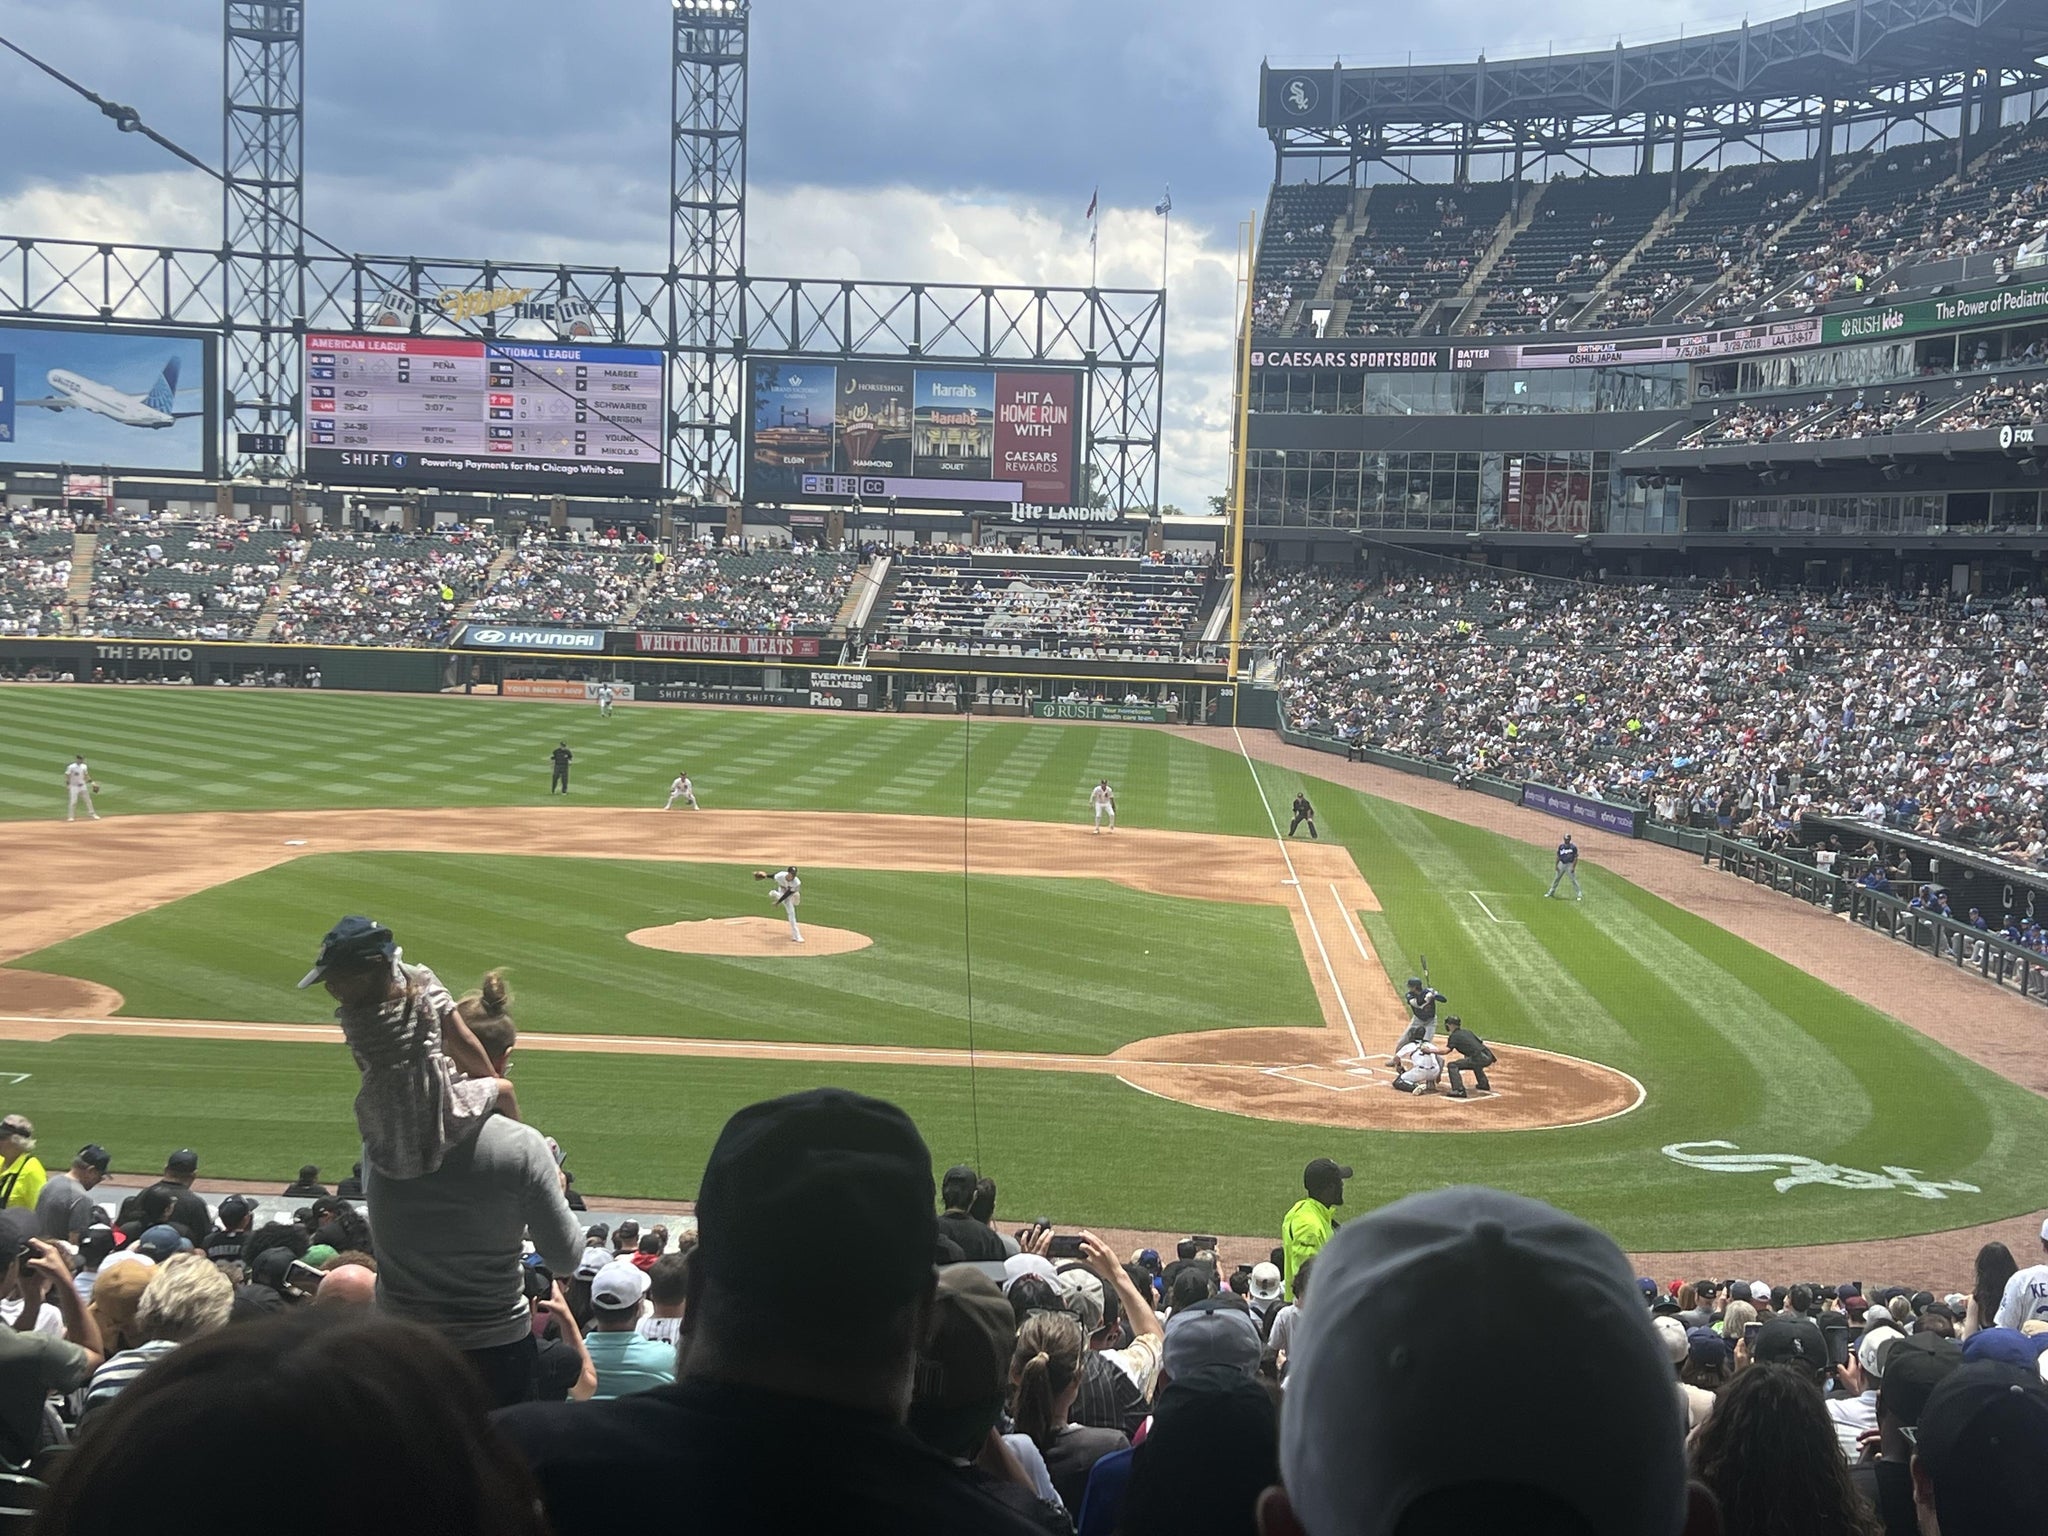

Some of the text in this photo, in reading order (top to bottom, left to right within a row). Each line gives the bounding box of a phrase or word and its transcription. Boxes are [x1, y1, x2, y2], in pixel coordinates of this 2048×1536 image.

[439, 287, 532, 323] Miller
[513, 301, 556, 320] TIME
[1936, 302, 1955, 320] The
[1957, 298, 1988, 317] Power
[1990, 295, 2002, 312] of
[559, 301, 588, 323] Lite
[1850, 307, 1904, 336] RUSH kids
[311, 340, 407, 351] AMERICAN LEAGUE
[490, 347, 581, 359] NATIONAL LEAGUE
[1267, 351, 1437, 367] CAESARS SPORTSBOOK
[1457, 349, 1490, 359] BATTER
[1597, 352, 1622, 363] JAPAN
[1457, 359, 1472, 368] BIO
[604, 370, 639, 379] MARSEE
[858, 384, 905, 393] HORSESHOE
[932, 382, 977, 398] Harrah's
[1015, 392, 1054, 405] HIT A
[424, 403, 444, 412] 3:07
[594, 401, 648, 411] SCHWARBER
[930, 410, 977, 426] Harrah's
[1000, 404, 1067, 424] HOME RUN
[1014, 424, 1052, 437] WITH
[2014, 428, 2034, 443] FOX
[424, 436, 445, 444] 6:20
[606, 434, 635, 442] YOUNG
[602, 447, 639, 456] MIKOLAS
[1005, 451, 1058, 463] CAESARS
[341, 452, 390, 466] SHIFT
[420, 457, 463, 470] Powering
[465, 459, 508, 471] Payments
[510, 462, 524, 470] for
[525, 462, 540, 471] the
[541, 463, 579, 475] Chicago
[580, 464, 606, 474] White
[607, 465, 624, 475] Sox
[783, 456, 805, 465] ELGIN
[853, 460, 894, 468] HAMMOND
[941, 463, 964, 471] JOLIET
[866, 481, 882, 492] CC
[1010, 502, 1118, 523] Lite LANDING
[509, 632, 594, 646] HYUNDAI
[640, 634, 794, 655] WHITTINGHAM MEATS
[96, 645, 193, 661] THE PATIO
[810, 672, 873, 682] EVERYTHING
[810, 680, 864, 689] WELLNESS
[659, 690, 688, 698] SHIFT
[701, 692, 731, 700] SHIFT
[745, 693, 775, 702] SHIFT
[810, 691, 843, 707] Rate
[1058, 705, 1097, 719] RUSH
